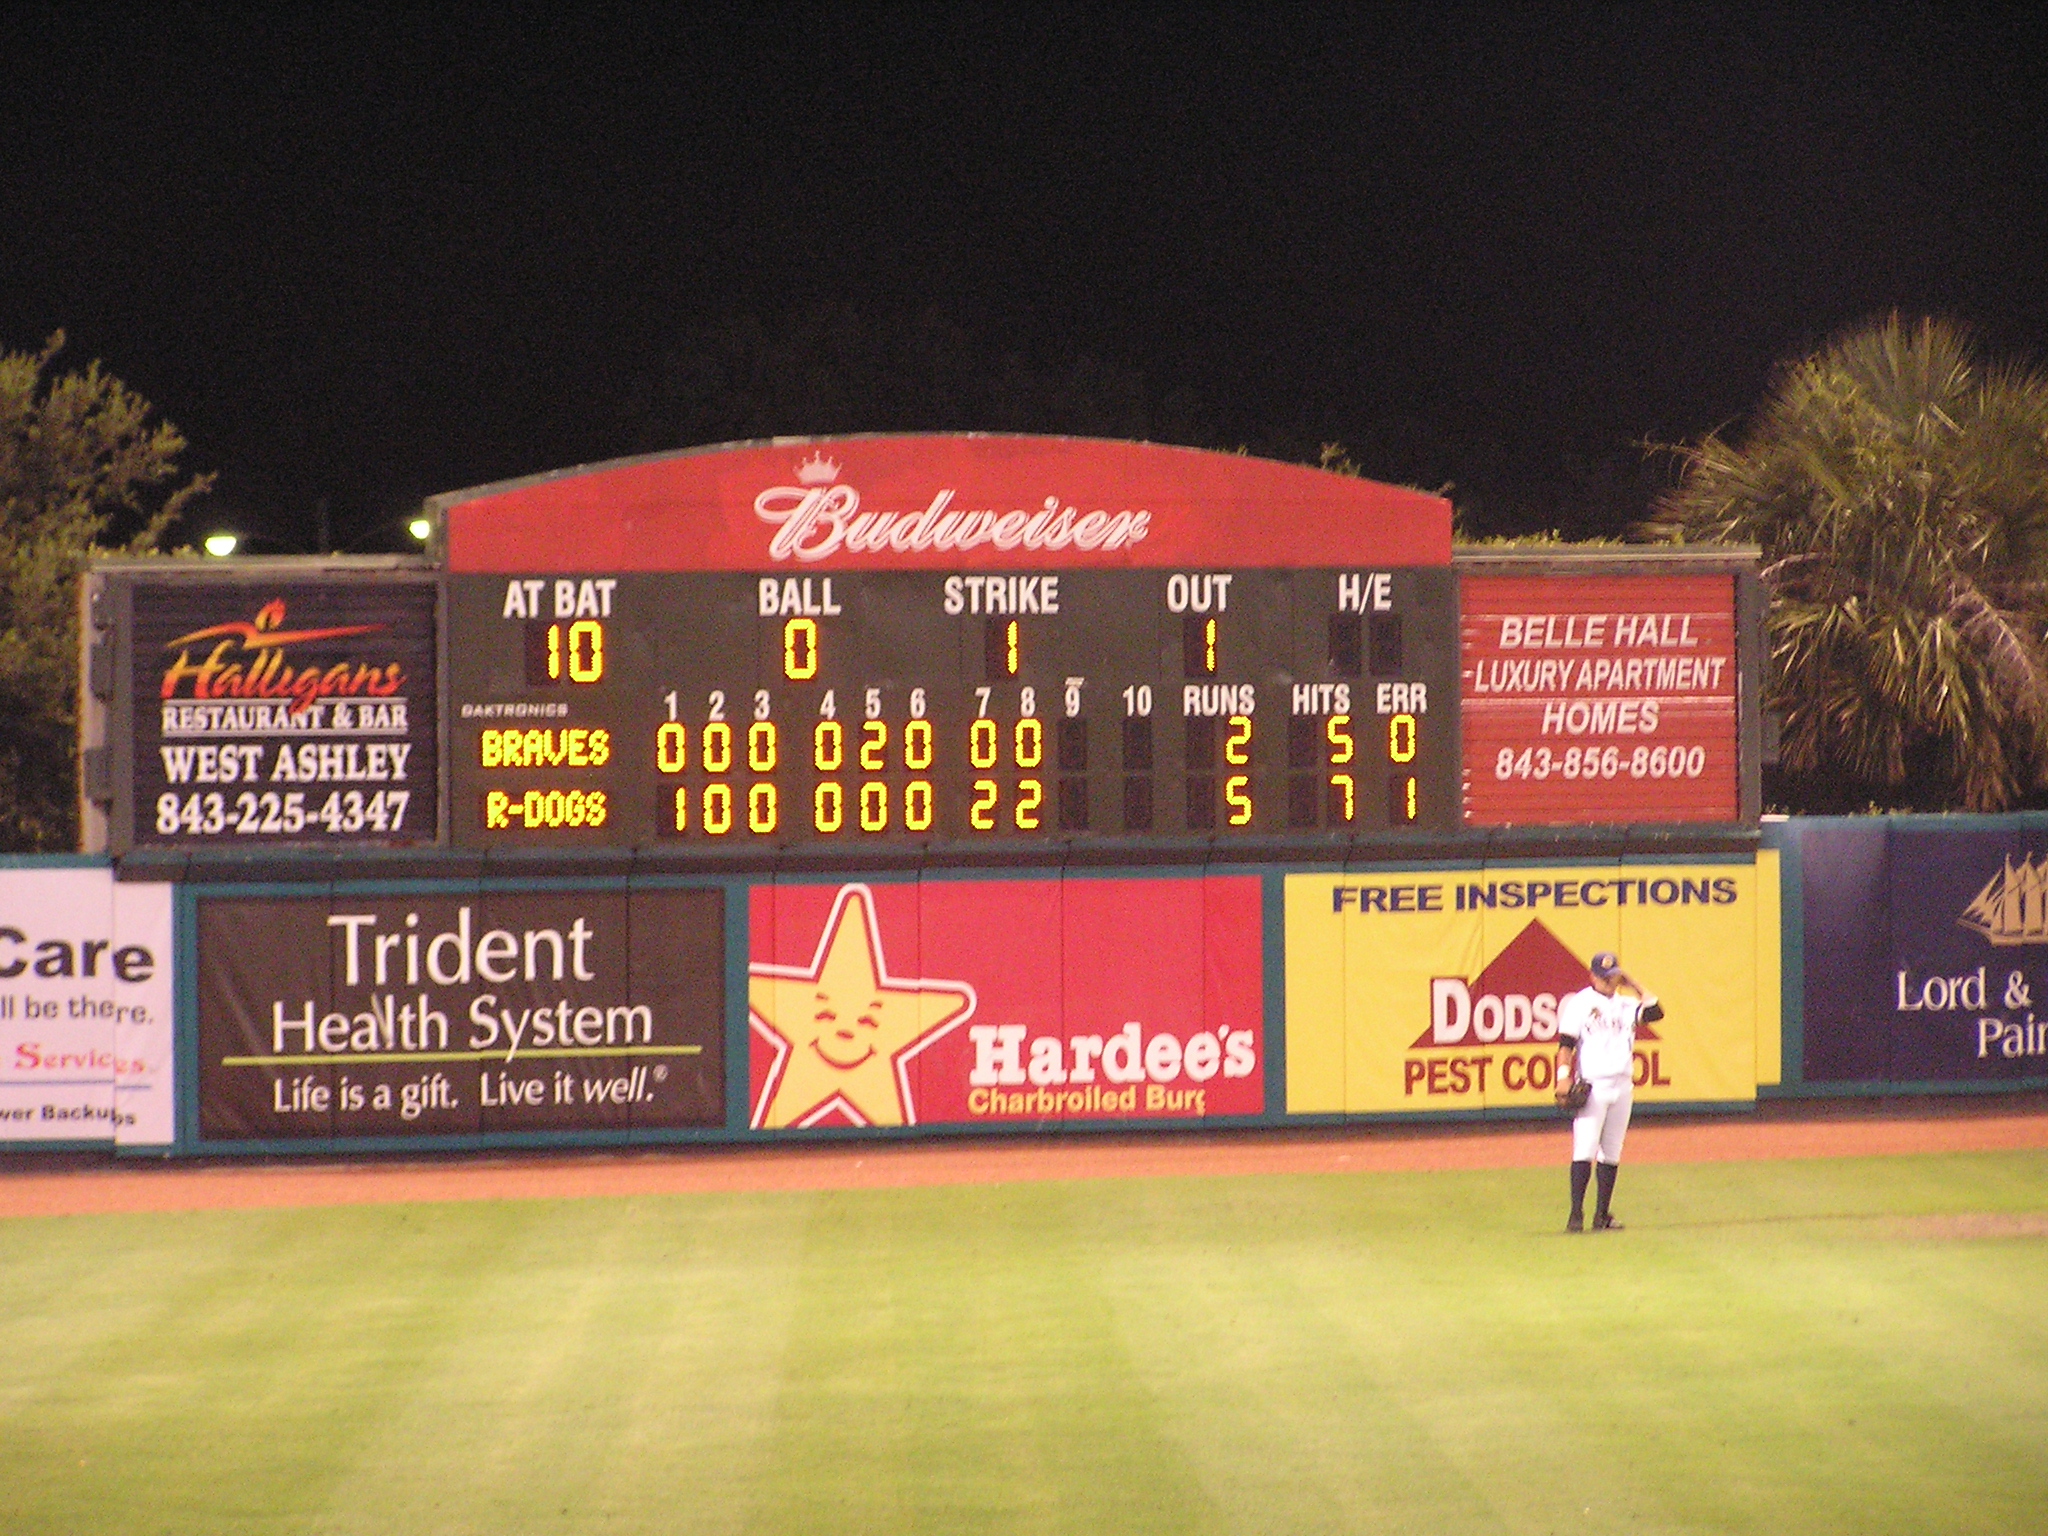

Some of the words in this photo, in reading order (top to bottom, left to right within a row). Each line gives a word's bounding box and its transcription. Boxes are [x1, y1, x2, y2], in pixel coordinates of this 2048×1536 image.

[754, 484, 1152, 562] Budweiser
[503, 580, 545, 619] AT
[554, 579, 617, 618] BAT
[759, 577, 841, 616] BALL
[944, 575, 1059, 614] STRIKE
[1167, 574, 1232, 613] OUT
[1338, 573, 1392, 614] H/E
[547, 620, 603, 683] 10
[784, 618, 817, 679] 0
[1006, 621, 1018, 674] 1
[1205, 618, 1216, 672] 1
[1500, 615, 1607, 649] BELLE
[1614, 614, 1699, 648] HALL
[160, 638, 407, 714] Halligans
[1474, 658, 1575, 692] LUXURY
[1575, 656, 1727, 691] APARTMENT
[163, 703, 325, 729] RESTAURANT
[332, 702, 354, 729] &
[359, 702, 408, 729] BAR
[461, 703, 568, 718] DAKTRONICS
[664, 691, 678, 721] 1
[709, 690, 726, 721] 2
[754, 690, 771, 721] 3
[820, 689, 837, 720] 4
[865, 688, 882, 719] 5
[910, 687, 926, 719] 6
[975, 687, 991, 718] 7
[1020, 686, 1036, 717] 8
[1065, 685, 1081, 718] 9
[1122, 685, 1152, 717] 10
[1183, 683, 1255, 716] RUNS
[1293, 683, 1350, 715] HITS
[1377, 682, 1427, 714] ERR
[1541, 700, 1660, 735] HOMES
[160, 745, 264, 784] WEST
[270, 743, 411, 782] ASHLEY
[482, 729, 610, 767] BRAVES
[657, 722, 686, 772] 0
[703, 722, 731, 772] 0
[748, 721, 776, 771] 0
[814, 721, 843, 770] 0
[860, 721, 887, 770] 2
[904, 720, 932, 770] 0
[970, 719, 997, 769] 0
[1015, 718, 1042, 768] 0
[1225, 715, 1251, 764] 2
[1328, 715, 1353, 763] 5
[1389, 714, 1416, 762] 0
[1495, 745, 1706, 780] 843-856-8600
[156, 791, 411, 835] 843-225-4347
[487, 790, 606, 828] R-DOGS
[675, 787, 686, 832] 1
[703, 783, 731, 834] 0
[748, 782, 776, 834] 0
[814, 781, 843, 832] 0
[860, 781, 888, 831] 0
[904, 780, 932, 831] 0
[970, 779, 997, 829] 2
[1015, 779, 1042, 829] 2
[1225, 775, 1252, 824] 5
[1331, 775, 1354, 821] 7
[1406, 776, 1416, 820] 1
[1332, 884, 1444, 913] FREE
[1455, 876, 1739, 911] INSPECTIONS
[0, 925, 154, 983] Care
[327, 906, 594, 987] Trident
[1897, 965, 1987, 1011] Lord
[2004, 970, 2033, 1010] &
[25, 995, 58, 1019] be
[68, 995, 153, 1025] there.
[273, 994, 448, 1054] Health
[468, 993, 653, 1063] System
[969, 1021, 1256, 1086] Hardee's
[1404, 1055, 1493, 1097] PEST
[1502, 1049, 1672, 1093] COOL
[41, 1103, 137, 1126] Backups
[274, 1074, 331, 1113] Life
[340, 1076, 363, 1111] is
[373, 1083, 393, 1112] a
[400, 1072, 459, 1121] gift.
[480, 1071, 544, 1107] Live
[554, 1070, 575, 1105] it
[967, 1085, 1137, 1115] Charbroiled
